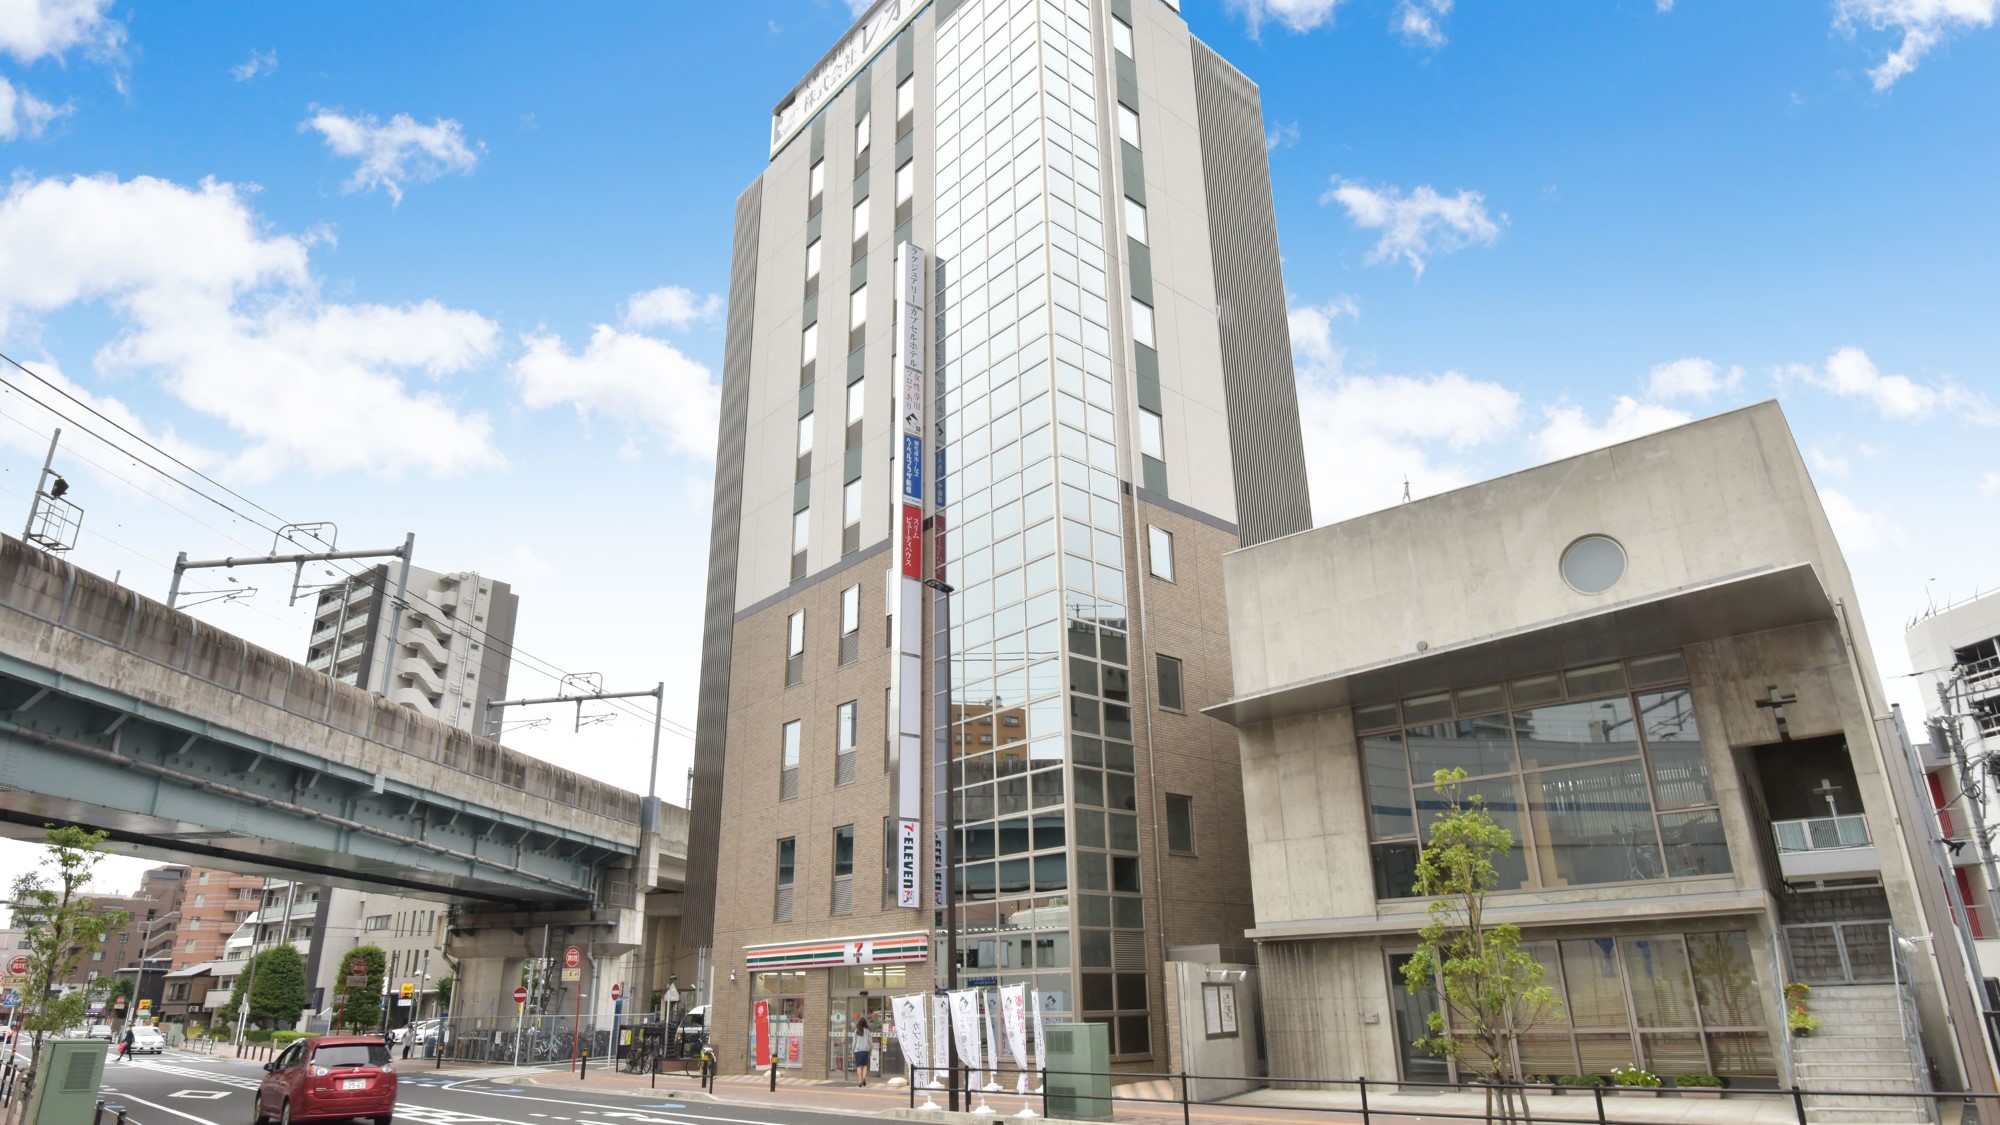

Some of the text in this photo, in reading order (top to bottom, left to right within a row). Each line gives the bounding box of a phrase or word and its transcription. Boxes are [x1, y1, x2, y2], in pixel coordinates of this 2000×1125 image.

[909, 307, 918, 367] カプセルホテル
[905, 370, 913, 410] フロアあり
[913, 373, 921, 411] 女性専用
[905, 516, 913, 567] ビューティハウス
